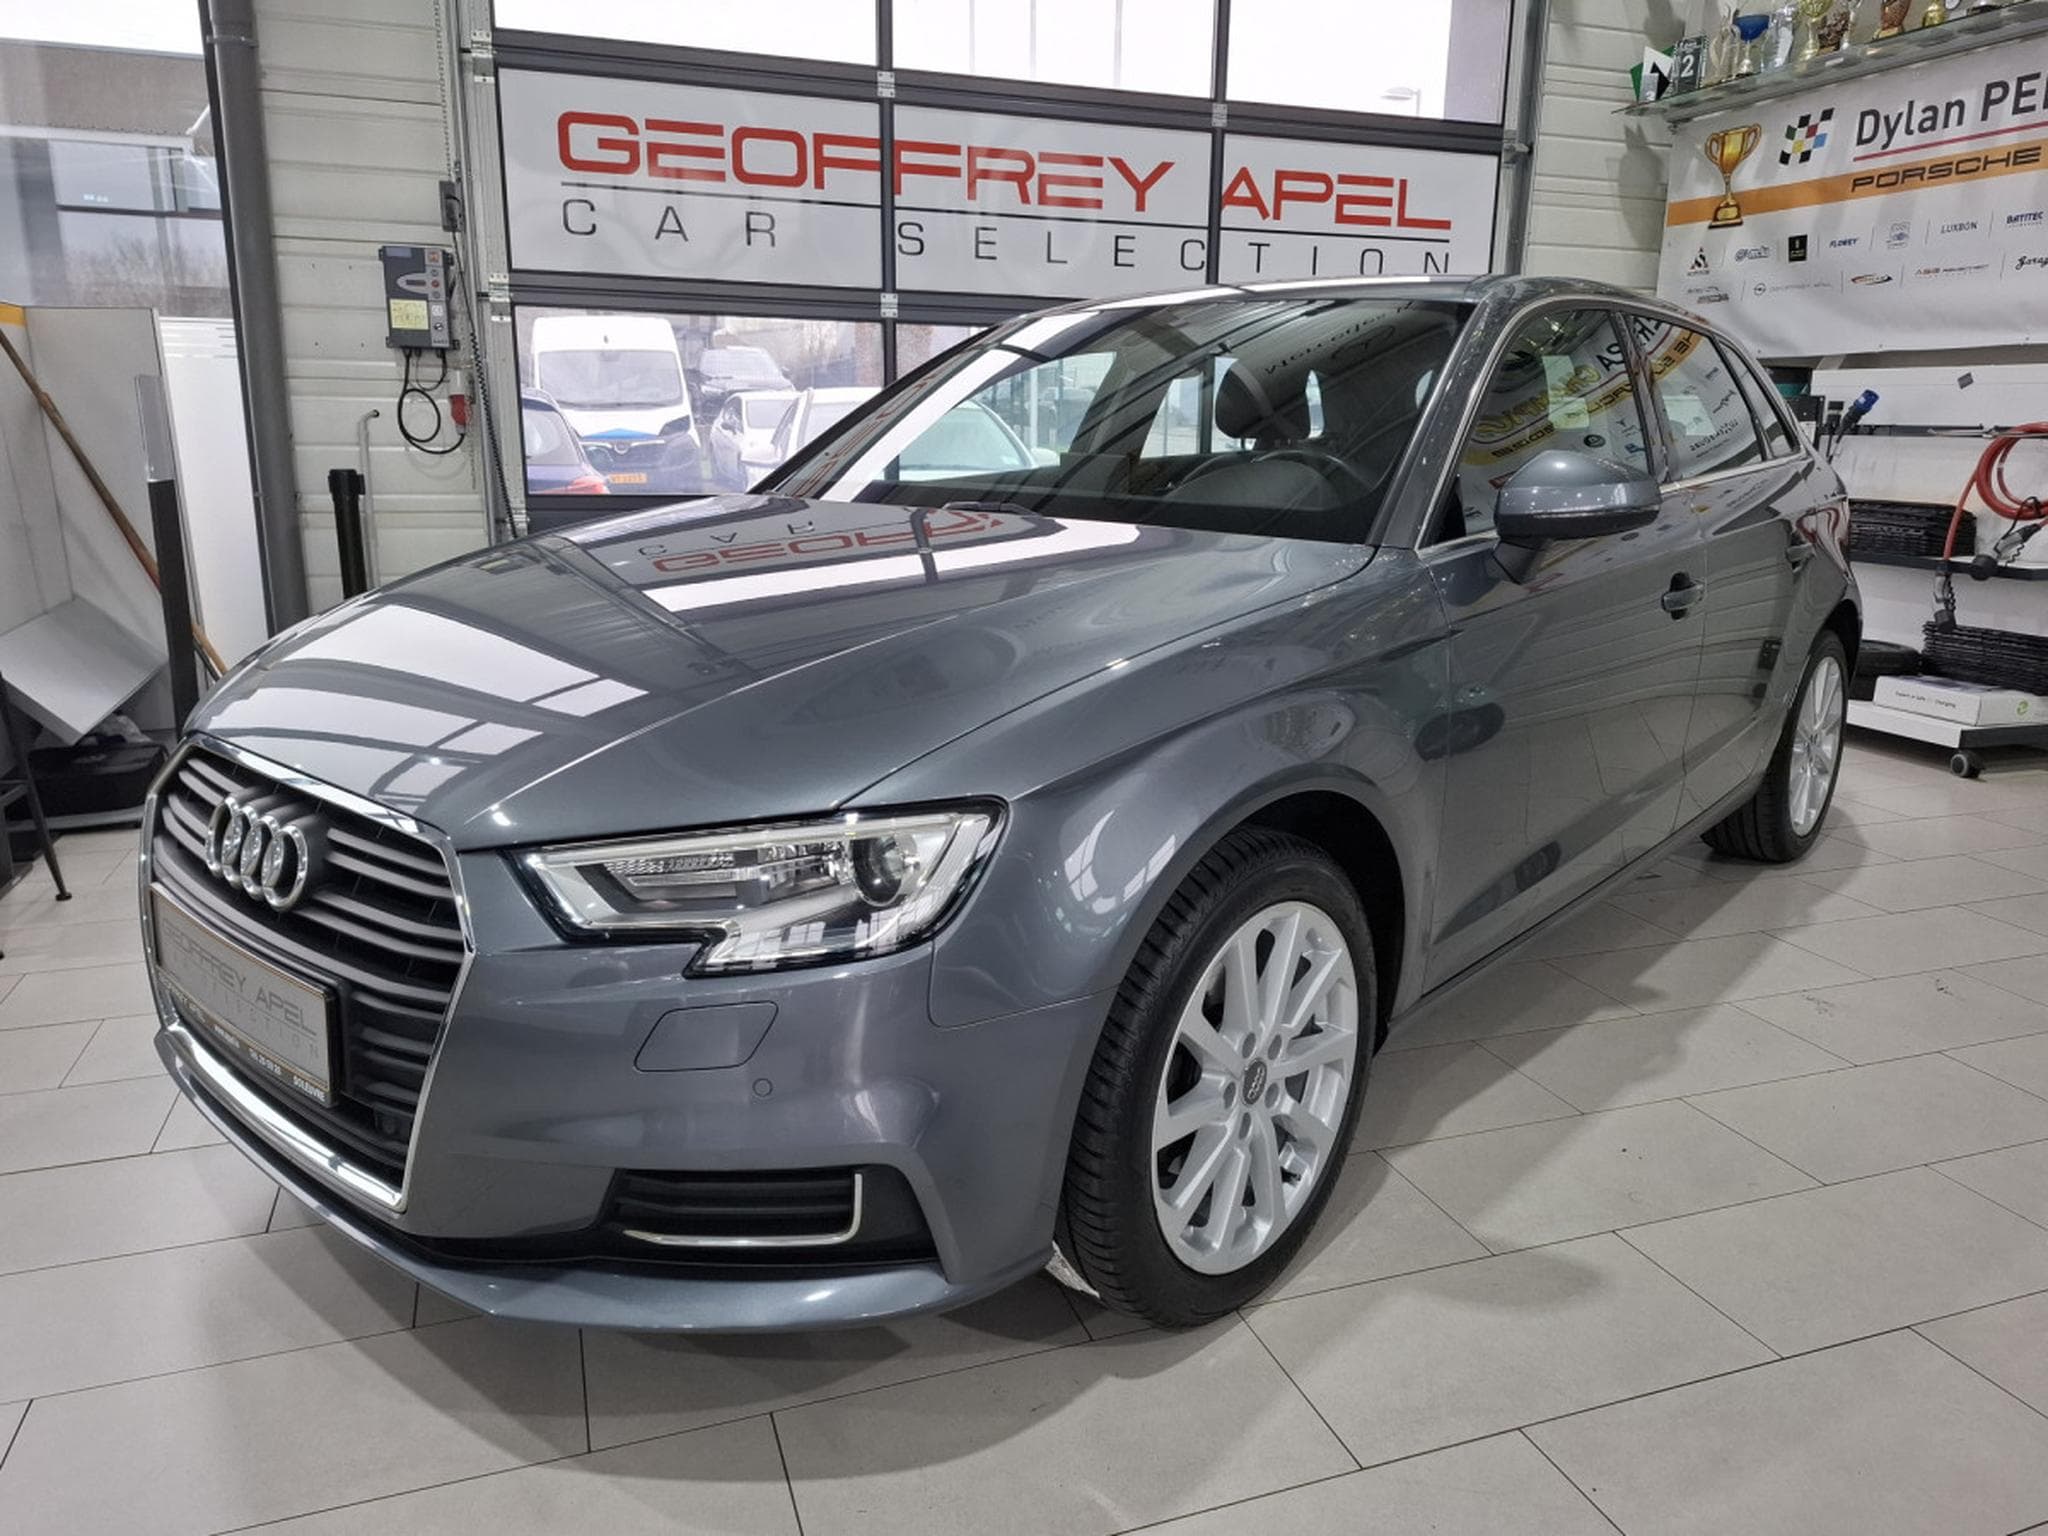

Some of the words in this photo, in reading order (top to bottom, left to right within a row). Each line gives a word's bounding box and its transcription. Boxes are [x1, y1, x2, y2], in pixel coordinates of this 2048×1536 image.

[1681, 54, 1694, 78] 2
[1856, 98, 1965, 150] Dylan
[557, 111, 1175, 213] GEOFFREY
[1221, 166, 1452, 231] APEL
[1851, 146, 2042, 193] PORSCHE
[562, 199, 776, 248] CAR
[897, 221, 1450, 275] SELECTION
[255, 987, 317, 1037] APEL
